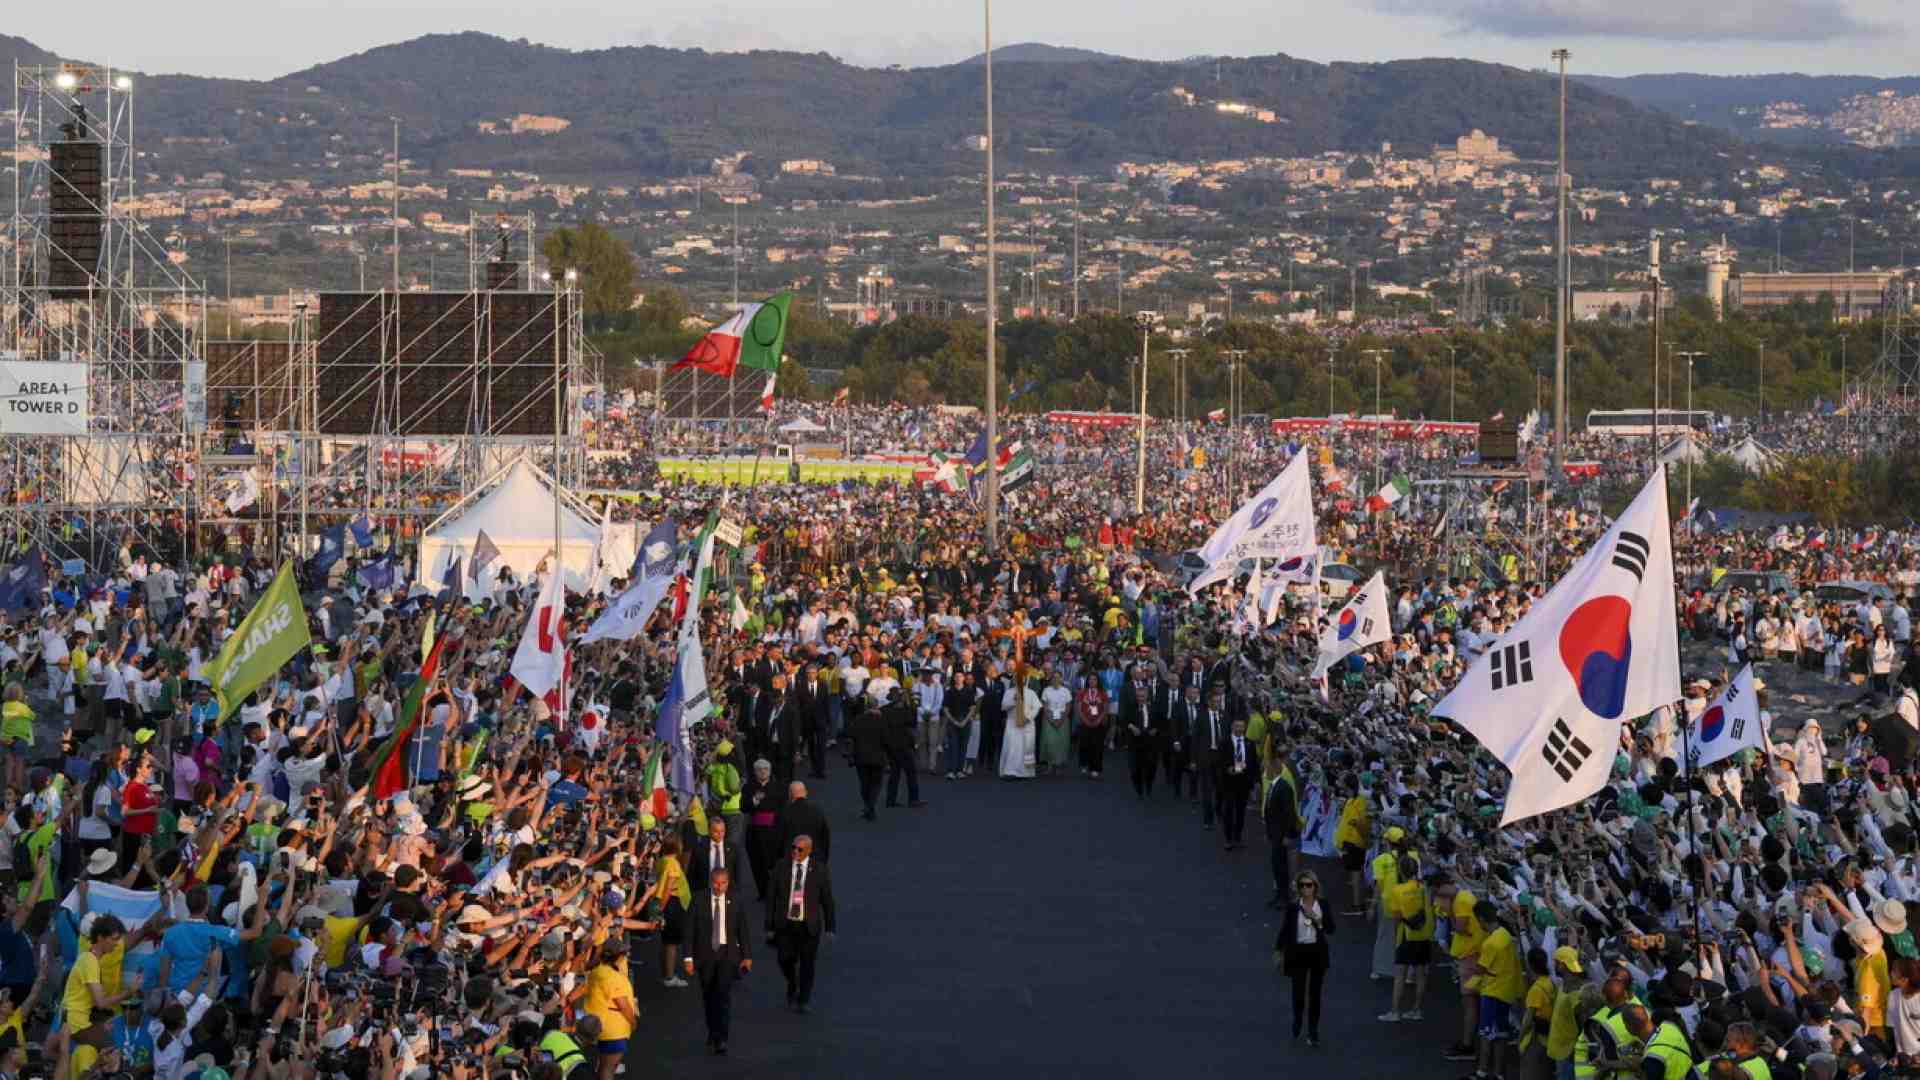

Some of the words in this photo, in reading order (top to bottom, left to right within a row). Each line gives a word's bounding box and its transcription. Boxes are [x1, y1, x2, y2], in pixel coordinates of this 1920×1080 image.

[19, 382, 59, 395] AREA
[9, 399, 63, 413] TOWER
[68, 400, 79, 413] D
